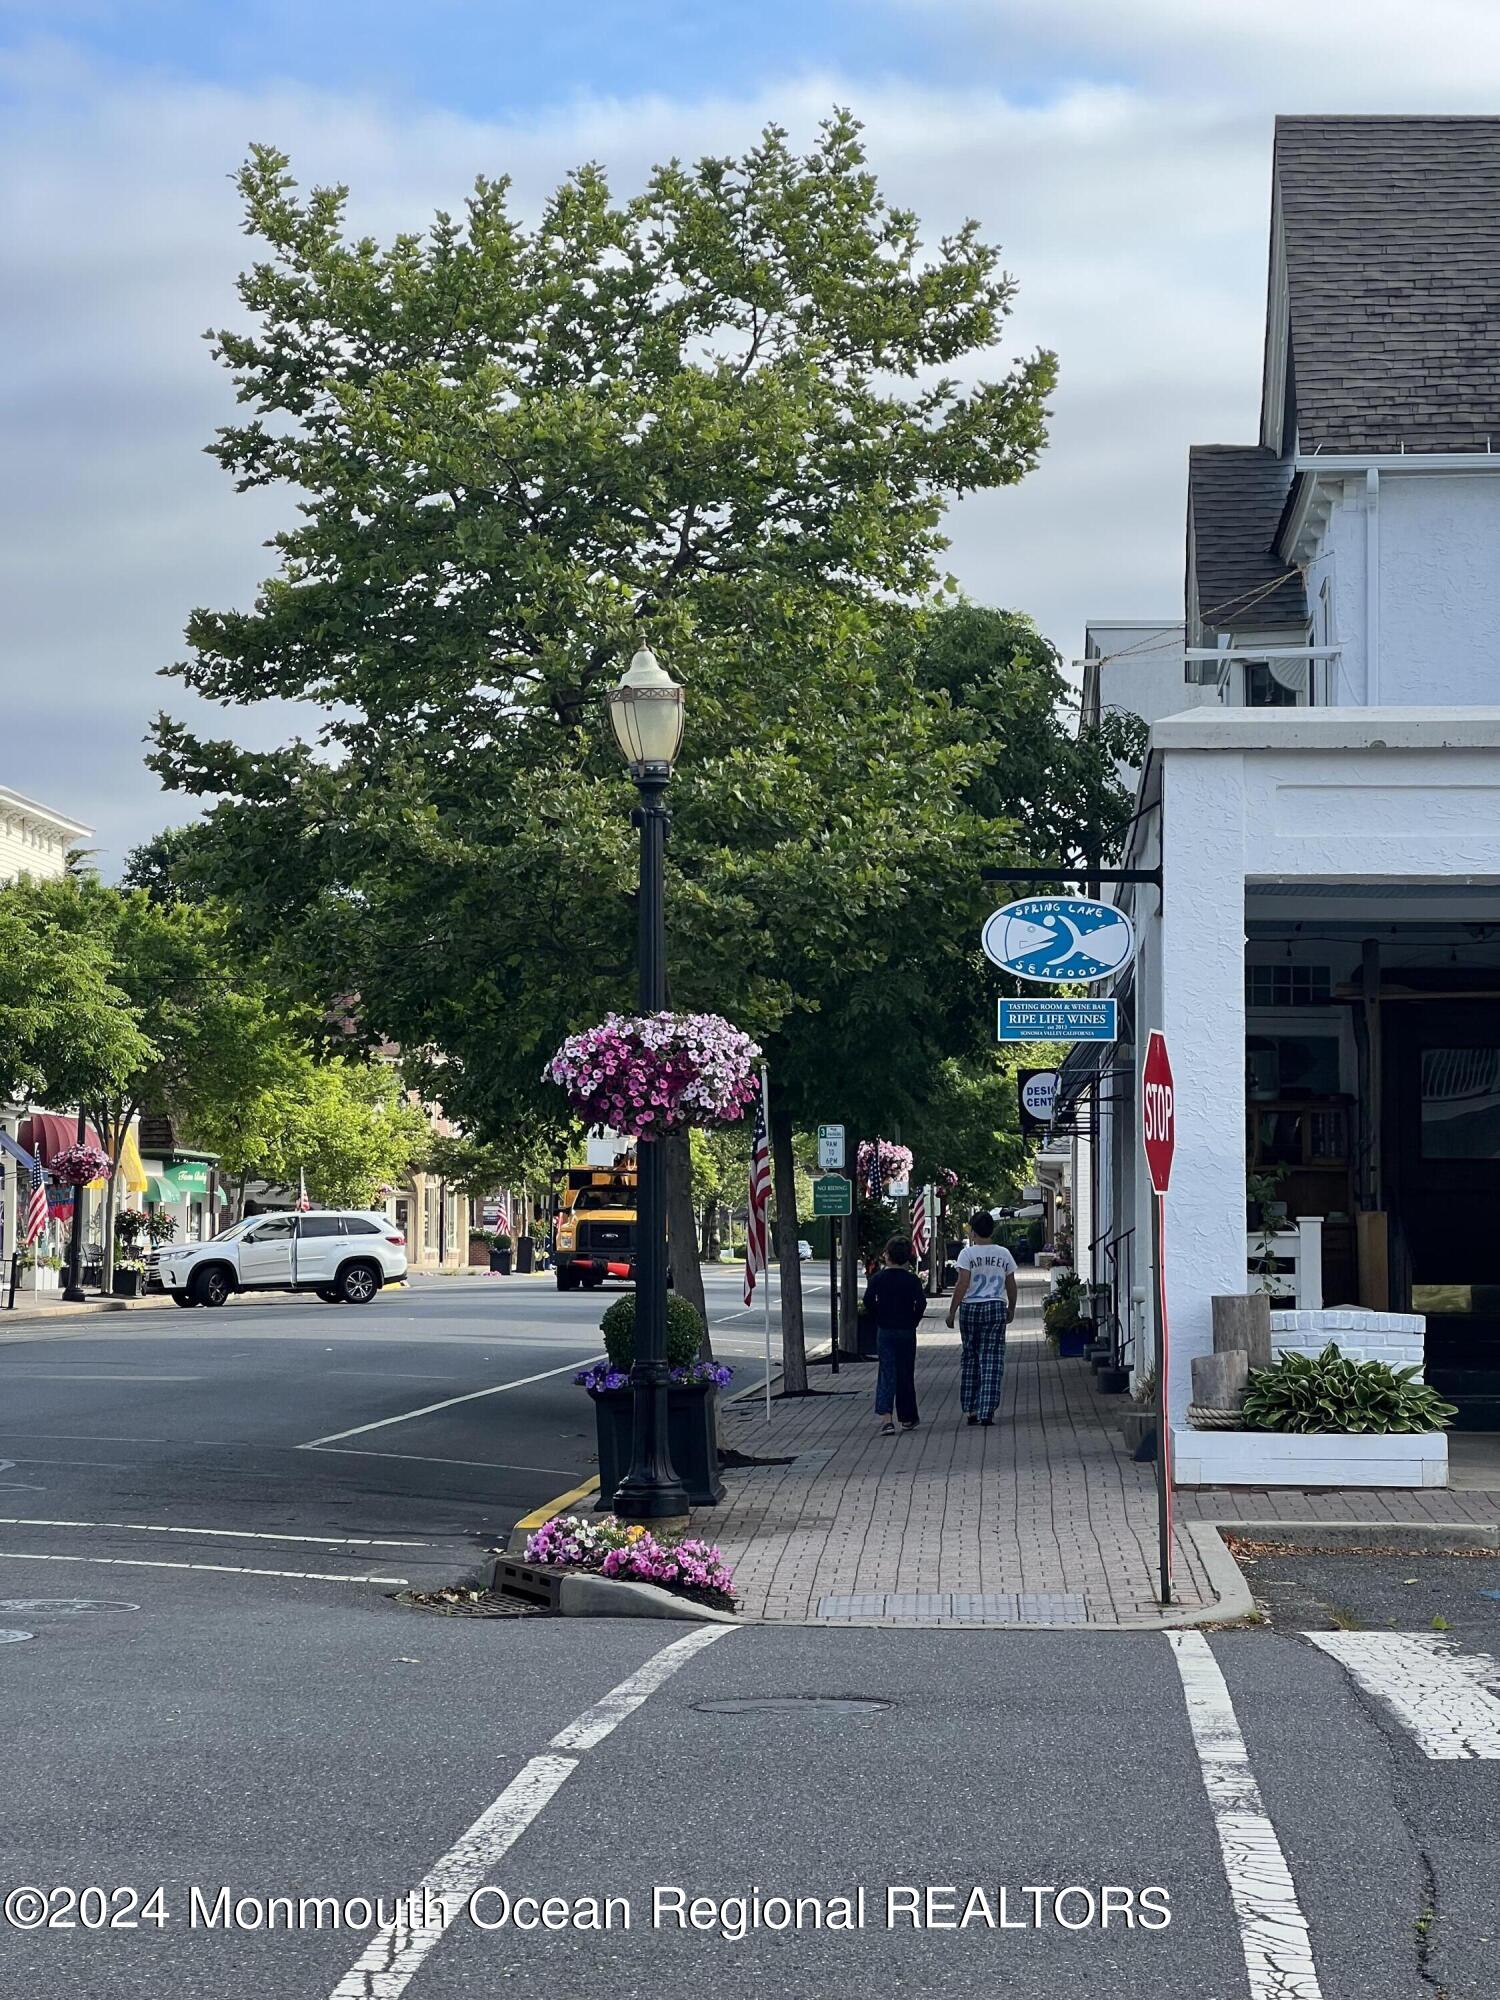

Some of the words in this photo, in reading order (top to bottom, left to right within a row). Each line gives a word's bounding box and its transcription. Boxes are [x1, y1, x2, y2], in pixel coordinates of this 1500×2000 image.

[1015, 902, 1061, 916] SPRING
[1068, 904, 1104, 917] LAKE
[1015, 960, 1097, 977] SEAFOOD
[1009, 1014, 1037, 1024] RIPE
[1039, 1014, 1065, 1024] LIFE
[1067, 1014, 1106, 1024] WINES
[1145, 1082, 1172, 1142] STOP
